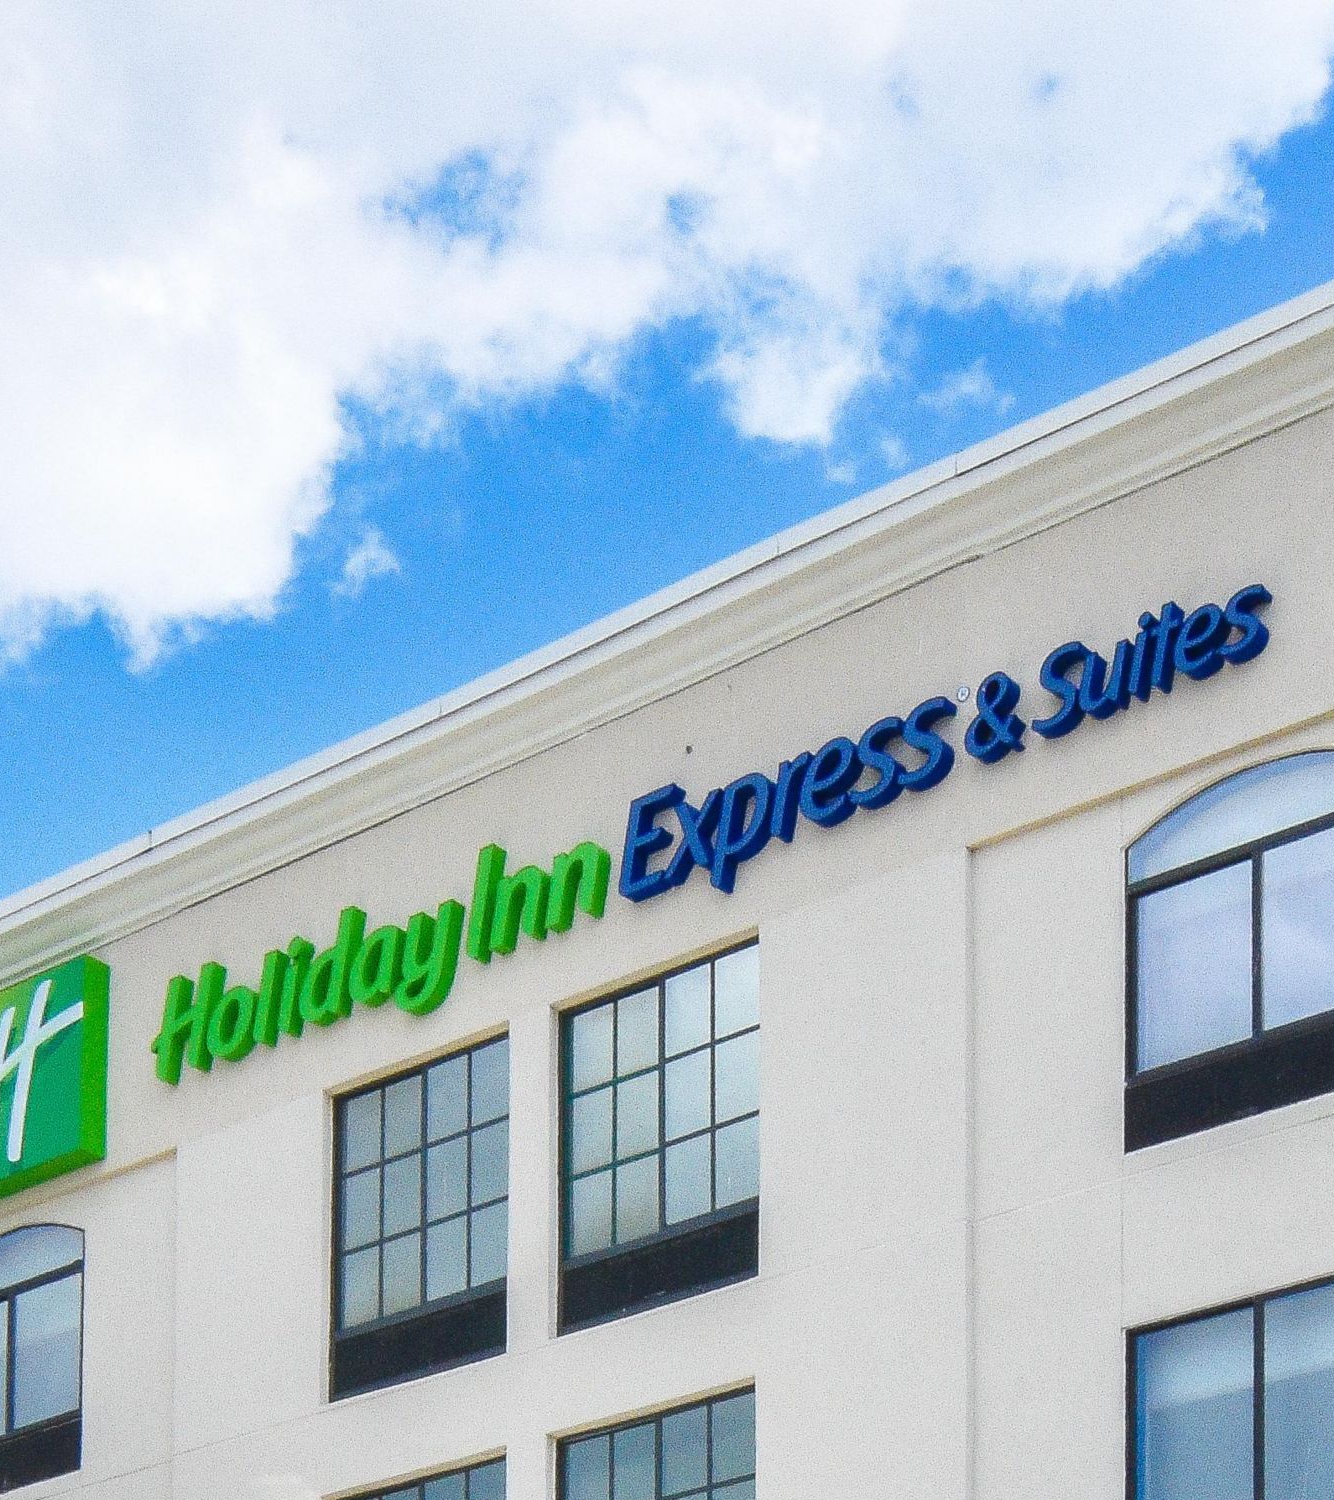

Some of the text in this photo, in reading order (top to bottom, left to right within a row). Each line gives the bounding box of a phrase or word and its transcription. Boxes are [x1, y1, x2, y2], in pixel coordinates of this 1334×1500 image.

[151, 899, 465, 1085] Holiday
[467, 841, 611, 963] Inn
[965, 670, 1025, 764] &
[1031, 583, 1273, 738] Suites
